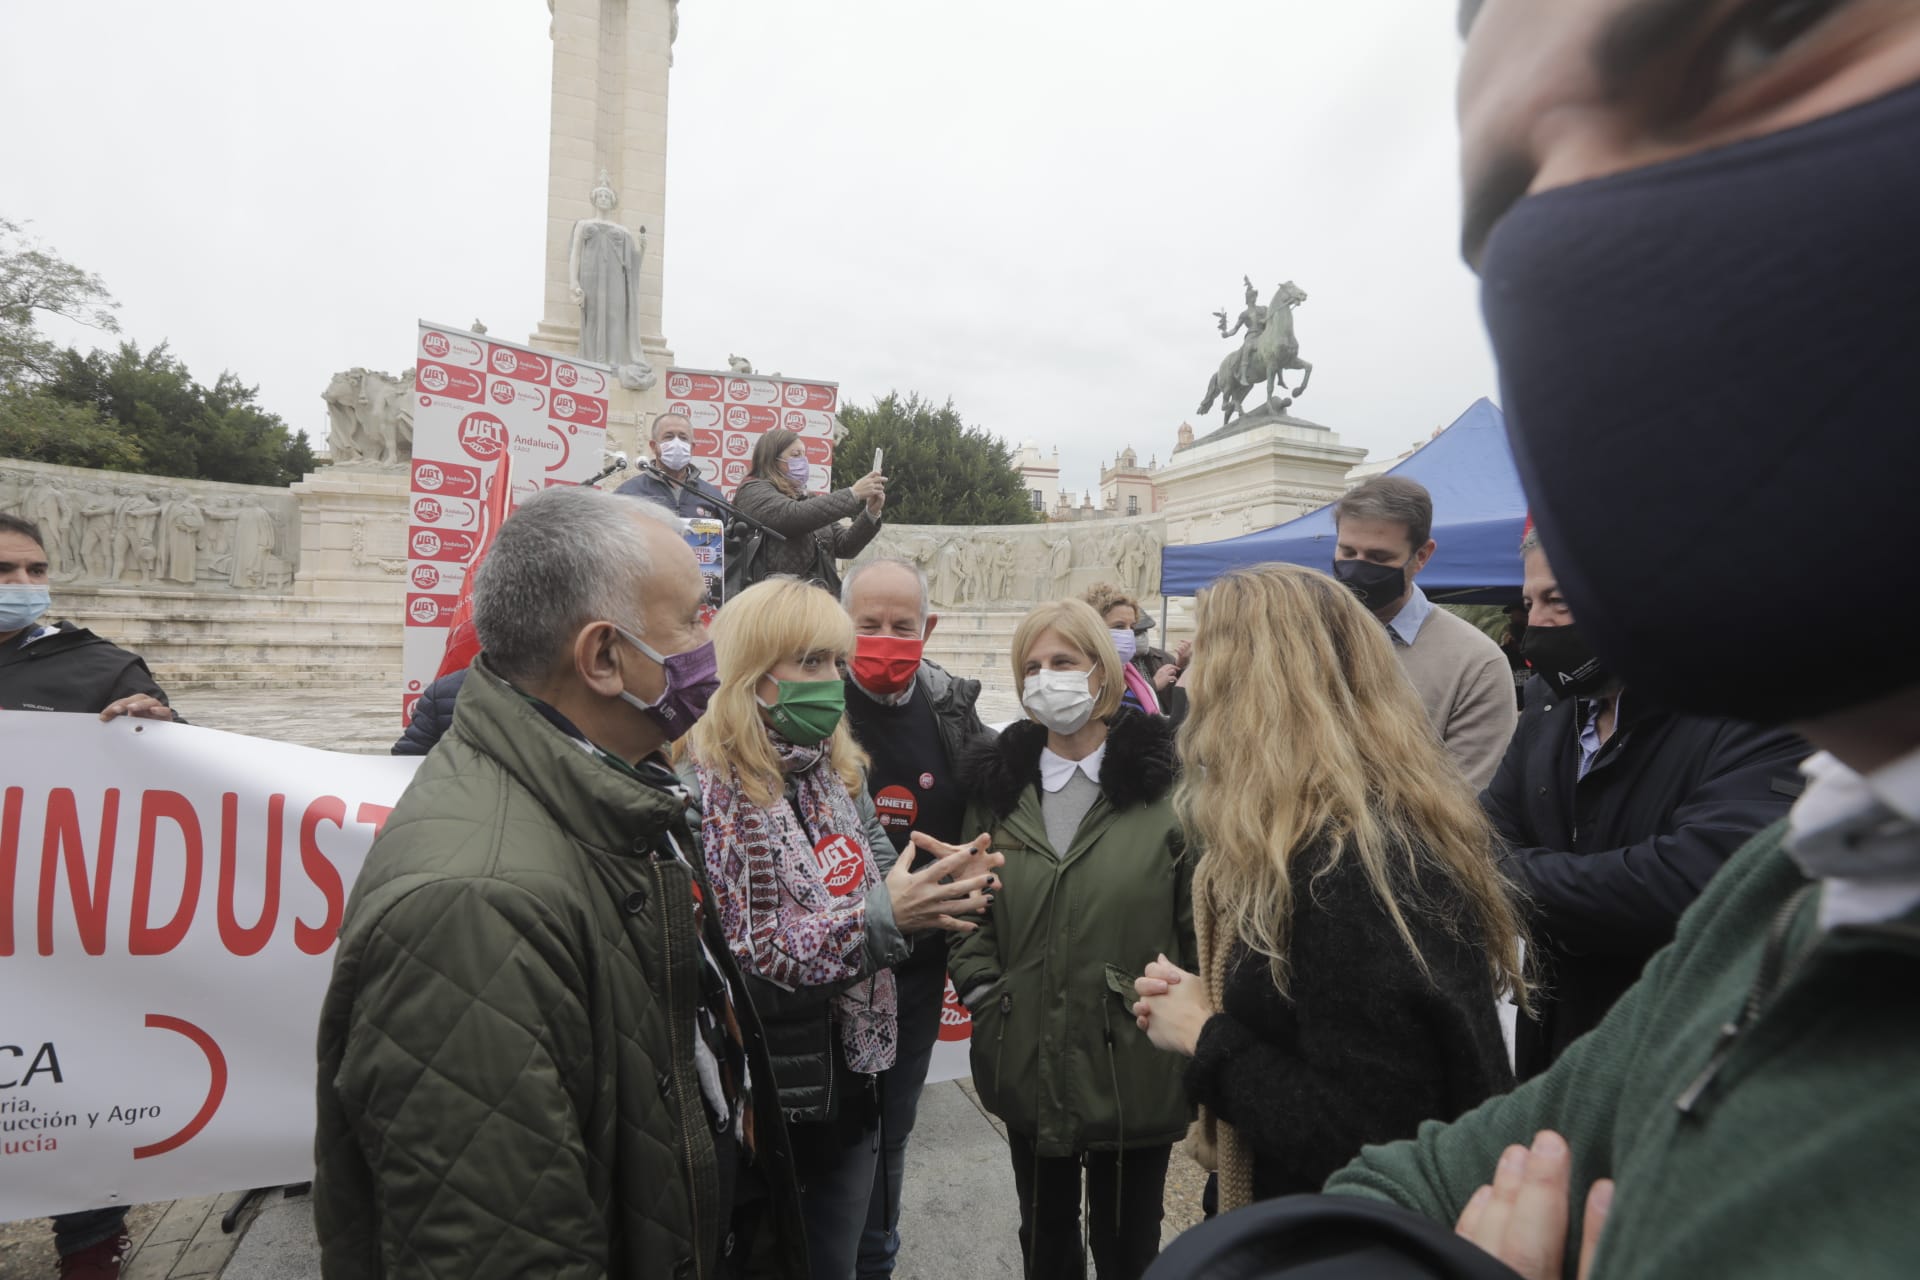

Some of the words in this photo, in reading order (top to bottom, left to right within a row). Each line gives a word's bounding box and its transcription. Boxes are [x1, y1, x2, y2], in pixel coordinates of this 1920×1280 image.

[425, 335, 446, 348] UGT
[496, 352, 513, 364] UGT
[423, 368, 445, 381] UGT
[559, 367, 575, 378] UGT
[671, 378, 688, 388] UGT
[730, 382, 747, 393] UGT
[494, 383, 513, 396] UGT
[787, 387, 804, 397] UGT
[556, 397, 573, 409] UGT
[730, 410, 746, 420] UGT
[464, 418, 503, 442] UGT
[514, 434, 559, 451] Andalucía
[729, 437, 746, 448] UGT
[419, 468, 440, 480] UGT
[729, 465, 744, 475] UGT
[417, 501, 439, 513] UGT
[416, 535, 437, 546] UGT
[415, 568, 436, 579] UGT
[413, 602, 435, 612] UGT
[660, 703, 677, 720] UGT
[877, 795, 914, 810] ÚNETE
[87, 1112, 100, 1128] y
[107, 1105, 161, 1126] Agro
